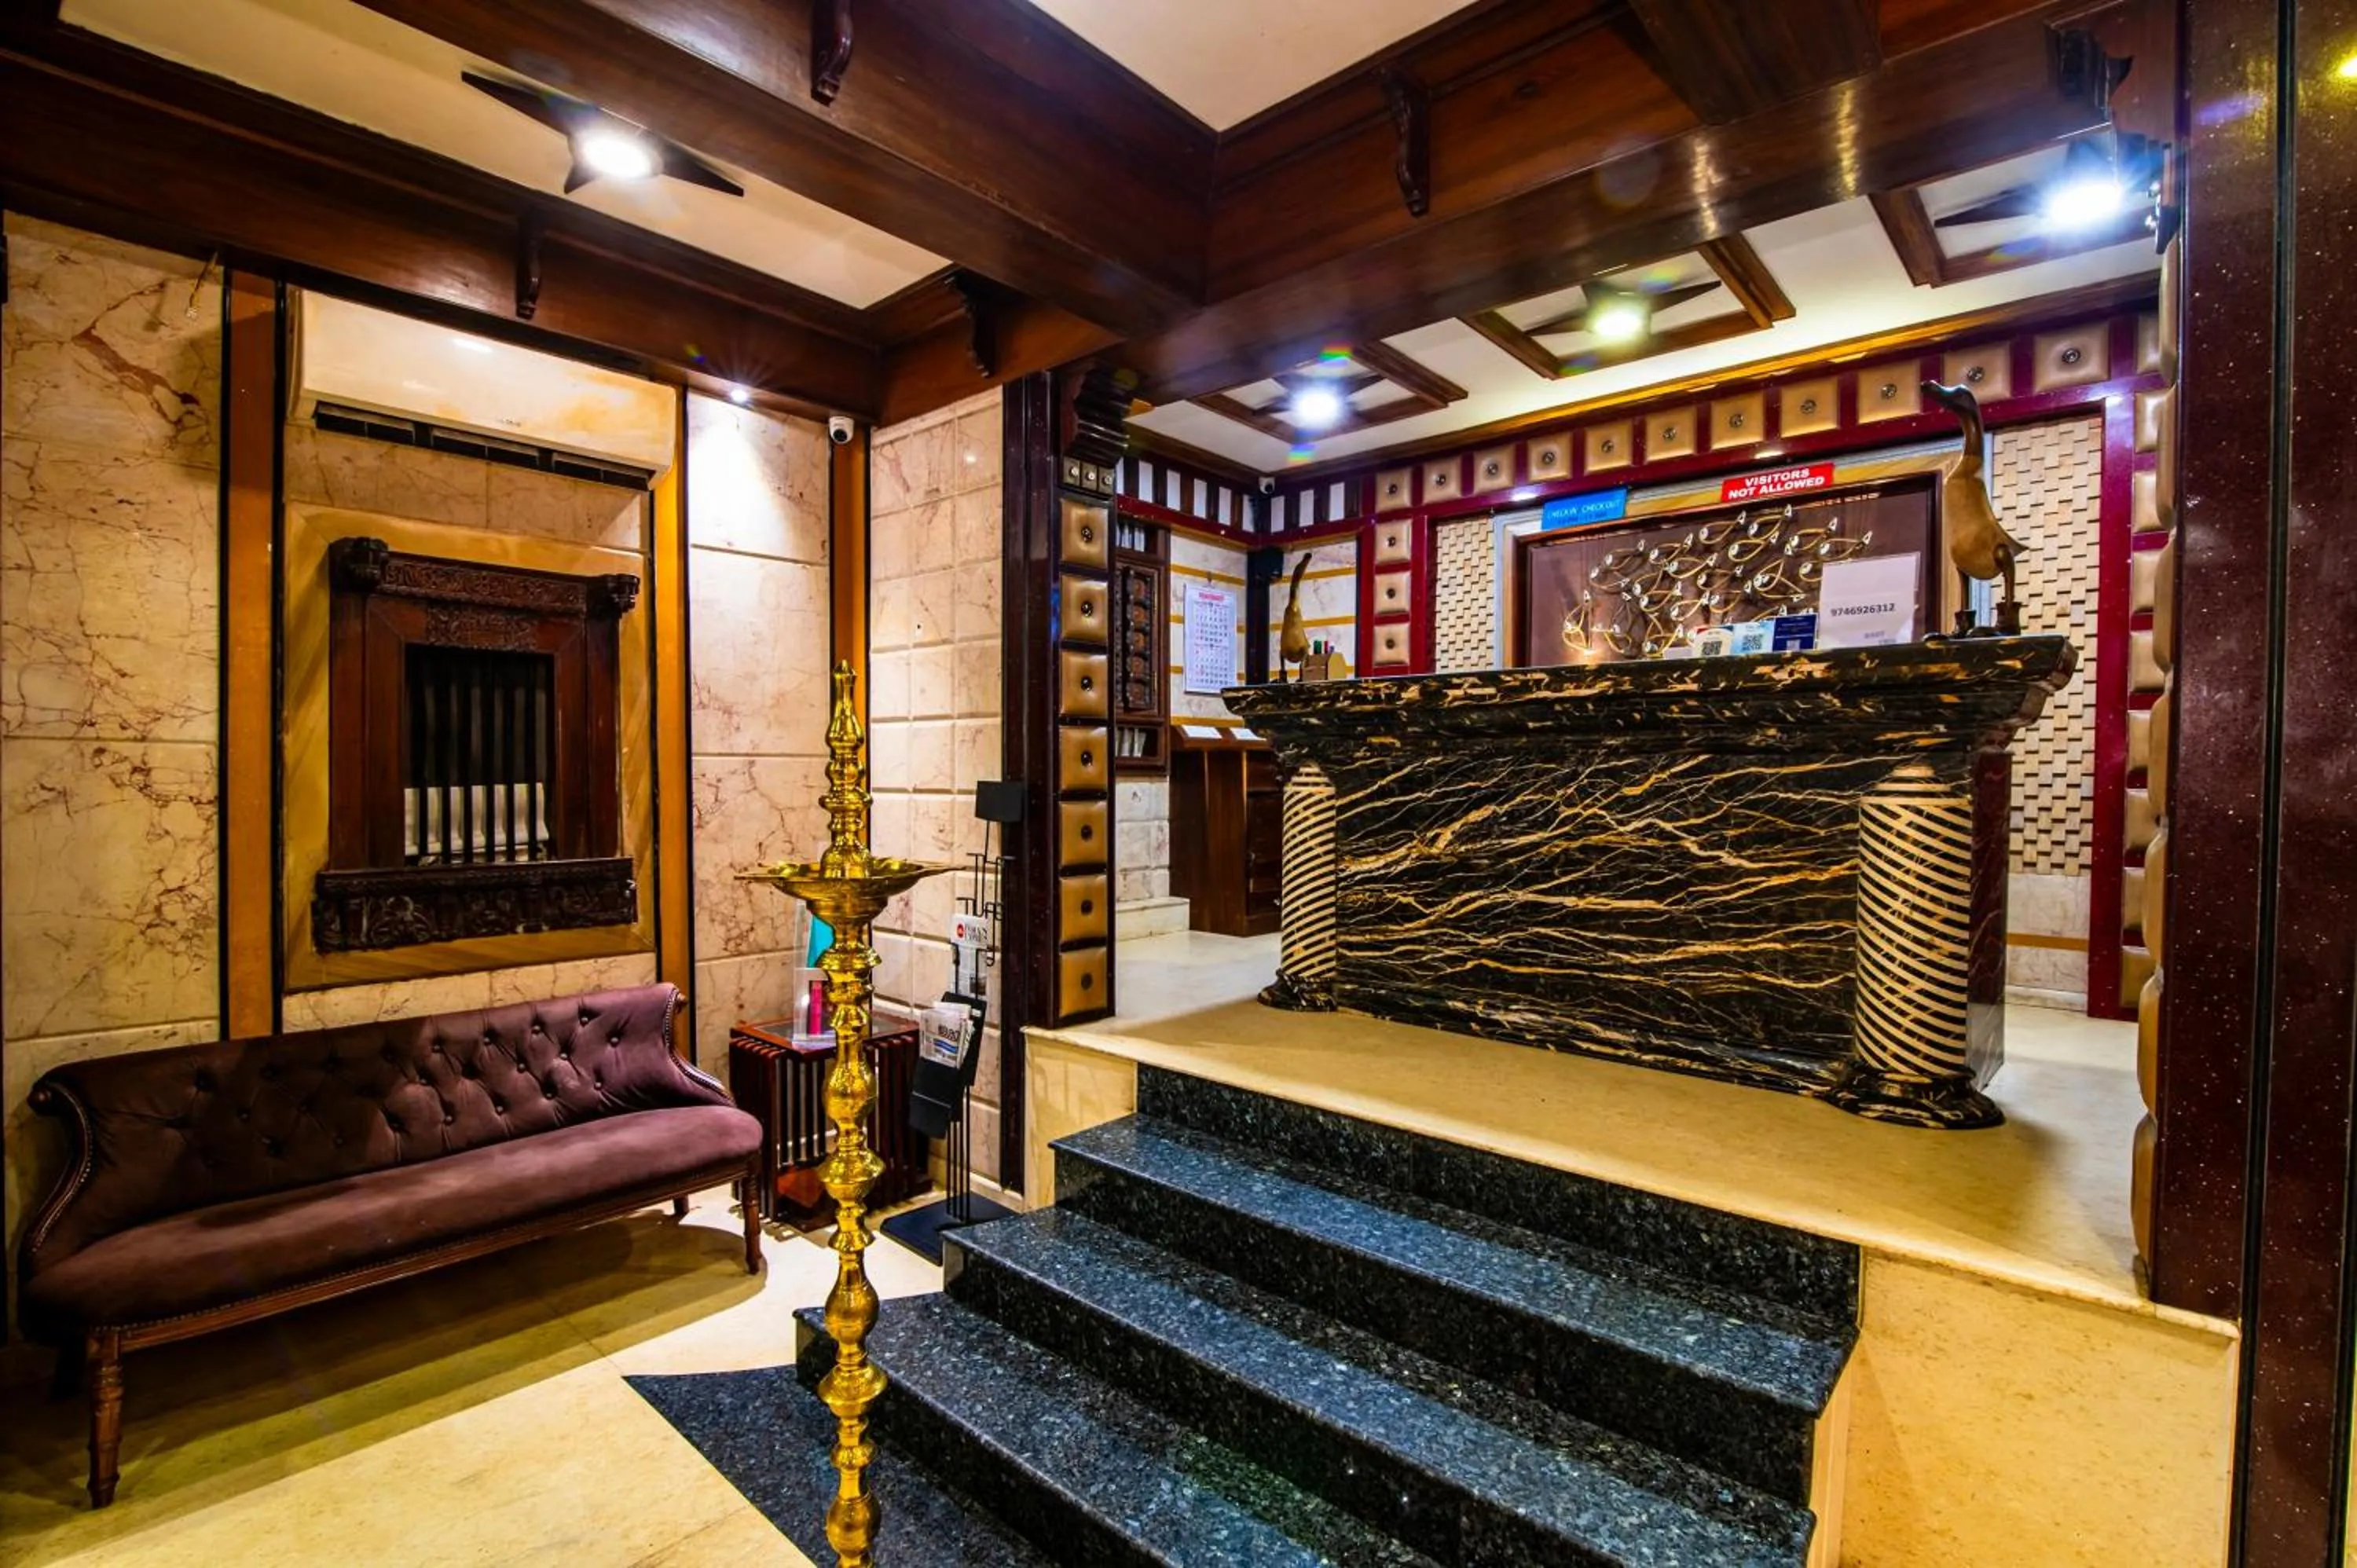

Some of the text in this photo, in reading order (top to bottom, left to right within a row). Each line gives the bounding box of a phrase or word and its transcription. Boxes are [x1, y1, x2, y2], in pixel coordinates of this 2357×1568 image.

[1745, 468, 1810, 487] VISITORS
[1728, 476, 1825, 500] NOT ALLOWED
[1830, 603, 1895, 617] 9746926312
